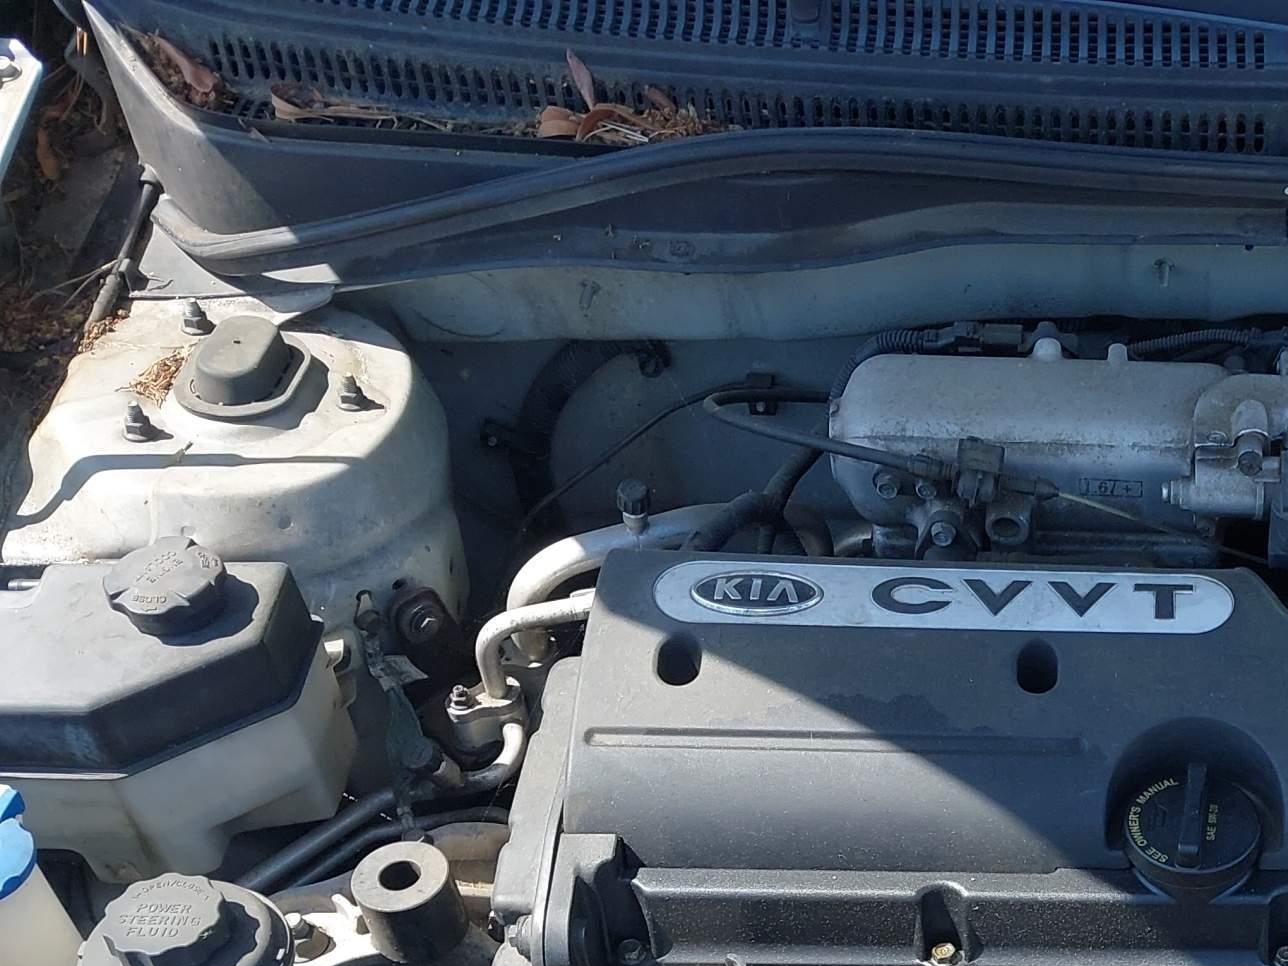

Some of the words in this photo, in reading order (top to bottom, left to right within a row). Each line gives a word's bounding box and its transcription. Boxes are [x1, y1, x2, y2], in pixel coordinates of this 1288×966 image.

[712, 577, 800, 603] KIA
[871, 575, 1197, 620] CVVT
[1135, 777, 1180, 805] MANUAL
[1128, 806, 1148, 847] OWNER'S
[1206, 825, 1217, 841] SAE
[1145, 846, 1168, 864] SEE
[136, 903, 192, 914] POWER
[119, 914, 201, 927] STEERING
[126, 927, 179, 938] FLUID
